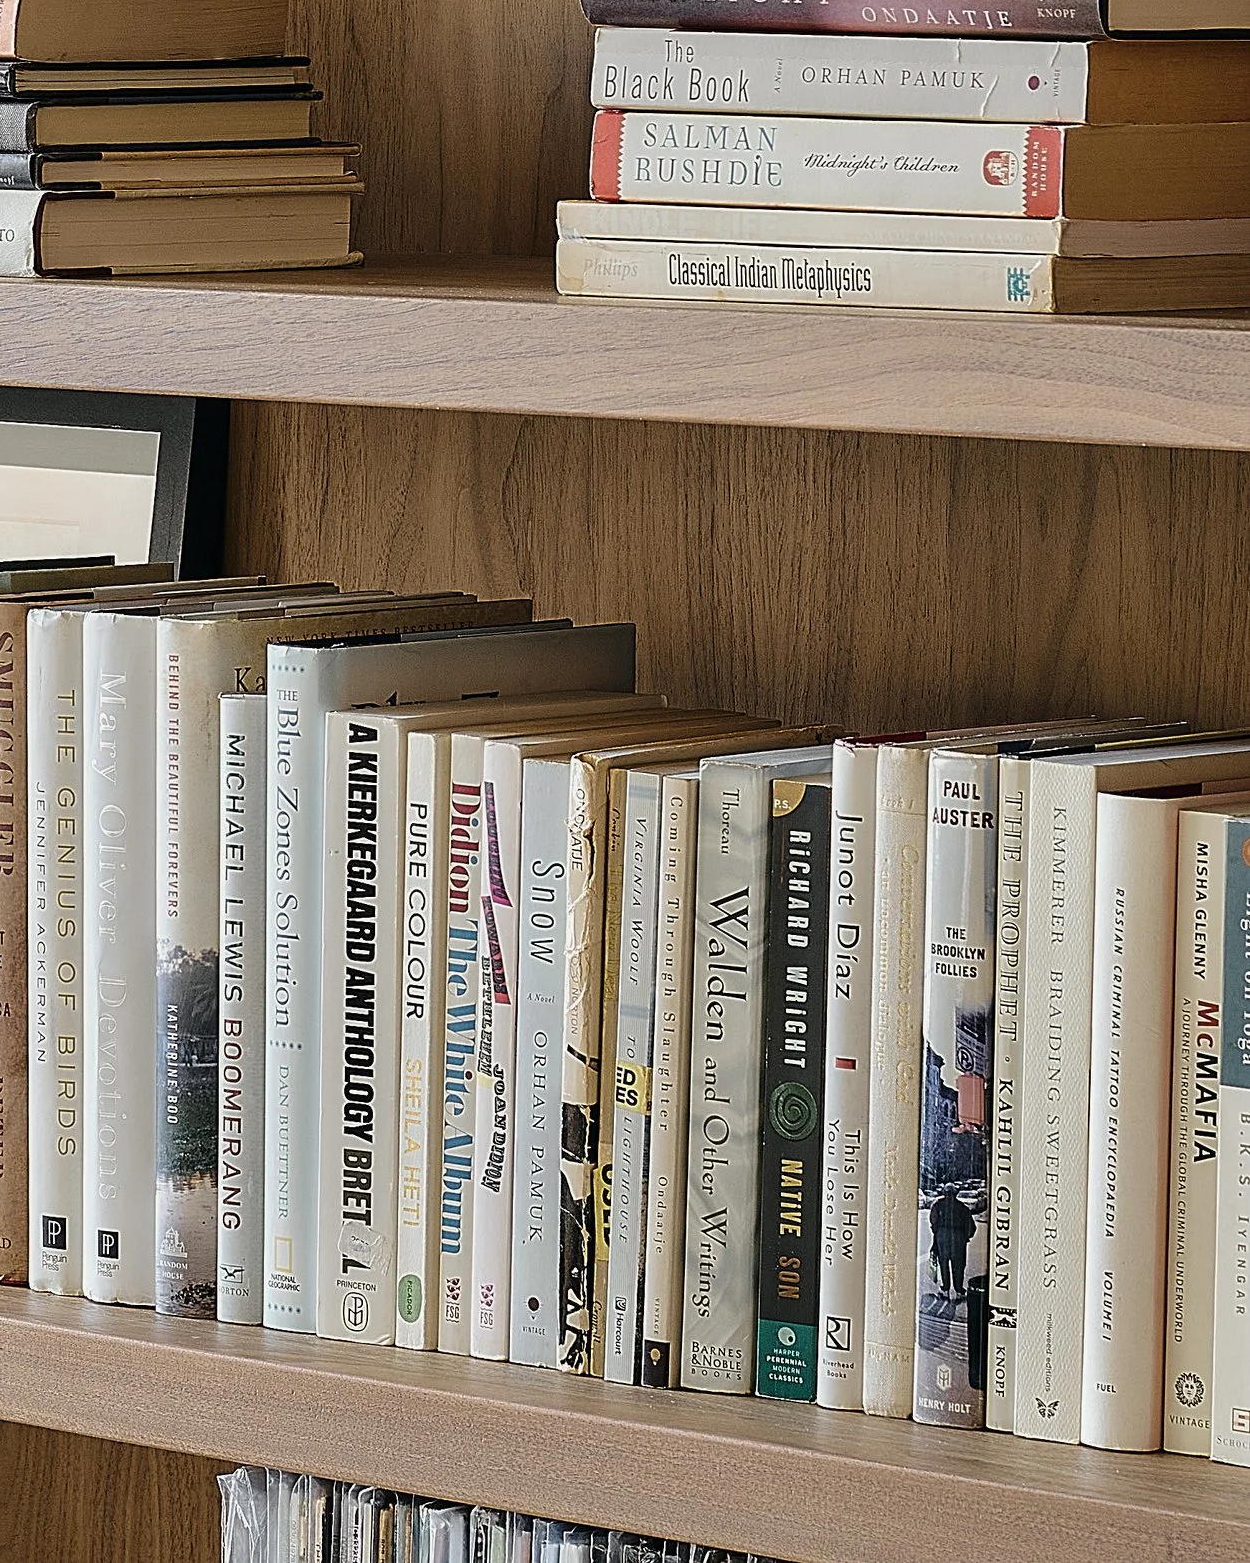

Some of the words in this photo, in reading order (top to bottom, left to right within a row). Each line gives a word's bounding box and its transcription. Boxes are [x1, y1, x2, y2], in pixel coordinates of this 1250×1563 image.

[861, 6, 1013, 28] ONDAATJE
[1037, 7, 1076, 20] KNOPF
[665, 40, 695, 63] The
[801, 66, 888, 87] ORHAN
[900, 70, 986, 90] PAMUK
[603, 66, 674, 101] Black
[689, 67, 751, 103] Book
[643, 123, 779, 152] SALMAN
[803, 152, 888, 177] Midnight's
[892, 153, 960, 174] Children
[634, 155, 784, 188] RUSHDIE
[668, 253, 730, 289] Classical
[734, 255, 778, 290] Indian
[781, 258, 872, 300] Metaphysics
[57, 690, 75, 763] THE
[348, 722, 377, 744] A
[225, 734, 246, 880] MICHAEL
[721, 789, 739, 854] Thoreau
[932, 809, 995, 829] AUSTER
[943, 781, 980, 800] PAUL
[57, 789, 76, 936] GENIUS
[346, 752, 377, 962] KIERKEGAARD
[408, 803, 427, 878] PURE
[450, 782, 481, 914] Didion
[835, 810, 863, 905] Junot
[1196, 842, 1208, 901] MISHA
[530, 861, 564, 963] Snow
[946, 927, 966, 940] THE
[1194, 909, 1207, 980] GLENNY
[223, 899, 244, 1002] LEWIS
[406, 889, 426, 1019] COLOUR
[705, 887, 749, 1041] Walden
[835, 924, 861, 1000] Díaz
[931, 944, 985, 960] BROOKLYN
[935, 963, 977, 978] FOLLIES
[58, 963, 76, 1010] OF
[342, 966, 376, 1143] ANTHOLOGY
[533, 1031, 547, 1130] ORHAN
[58, 1036, 76, 1155] BIRDS
[222, 1018, 243, 1230] BOOMERANG
[998, 1078, 1013, 1176] KAHLIL
[529, 1147, 544, 1241] PAMUK
[995, 1188, 1012, 1290] GIBRAN
[919, 1397, 945, 1410] HENRY
[948, 1403, 971, 1414] HOLT
[1096, 1383, 1116, 1393] FUEL
[1170, 1415, 1210, 1429] VINTAGE
